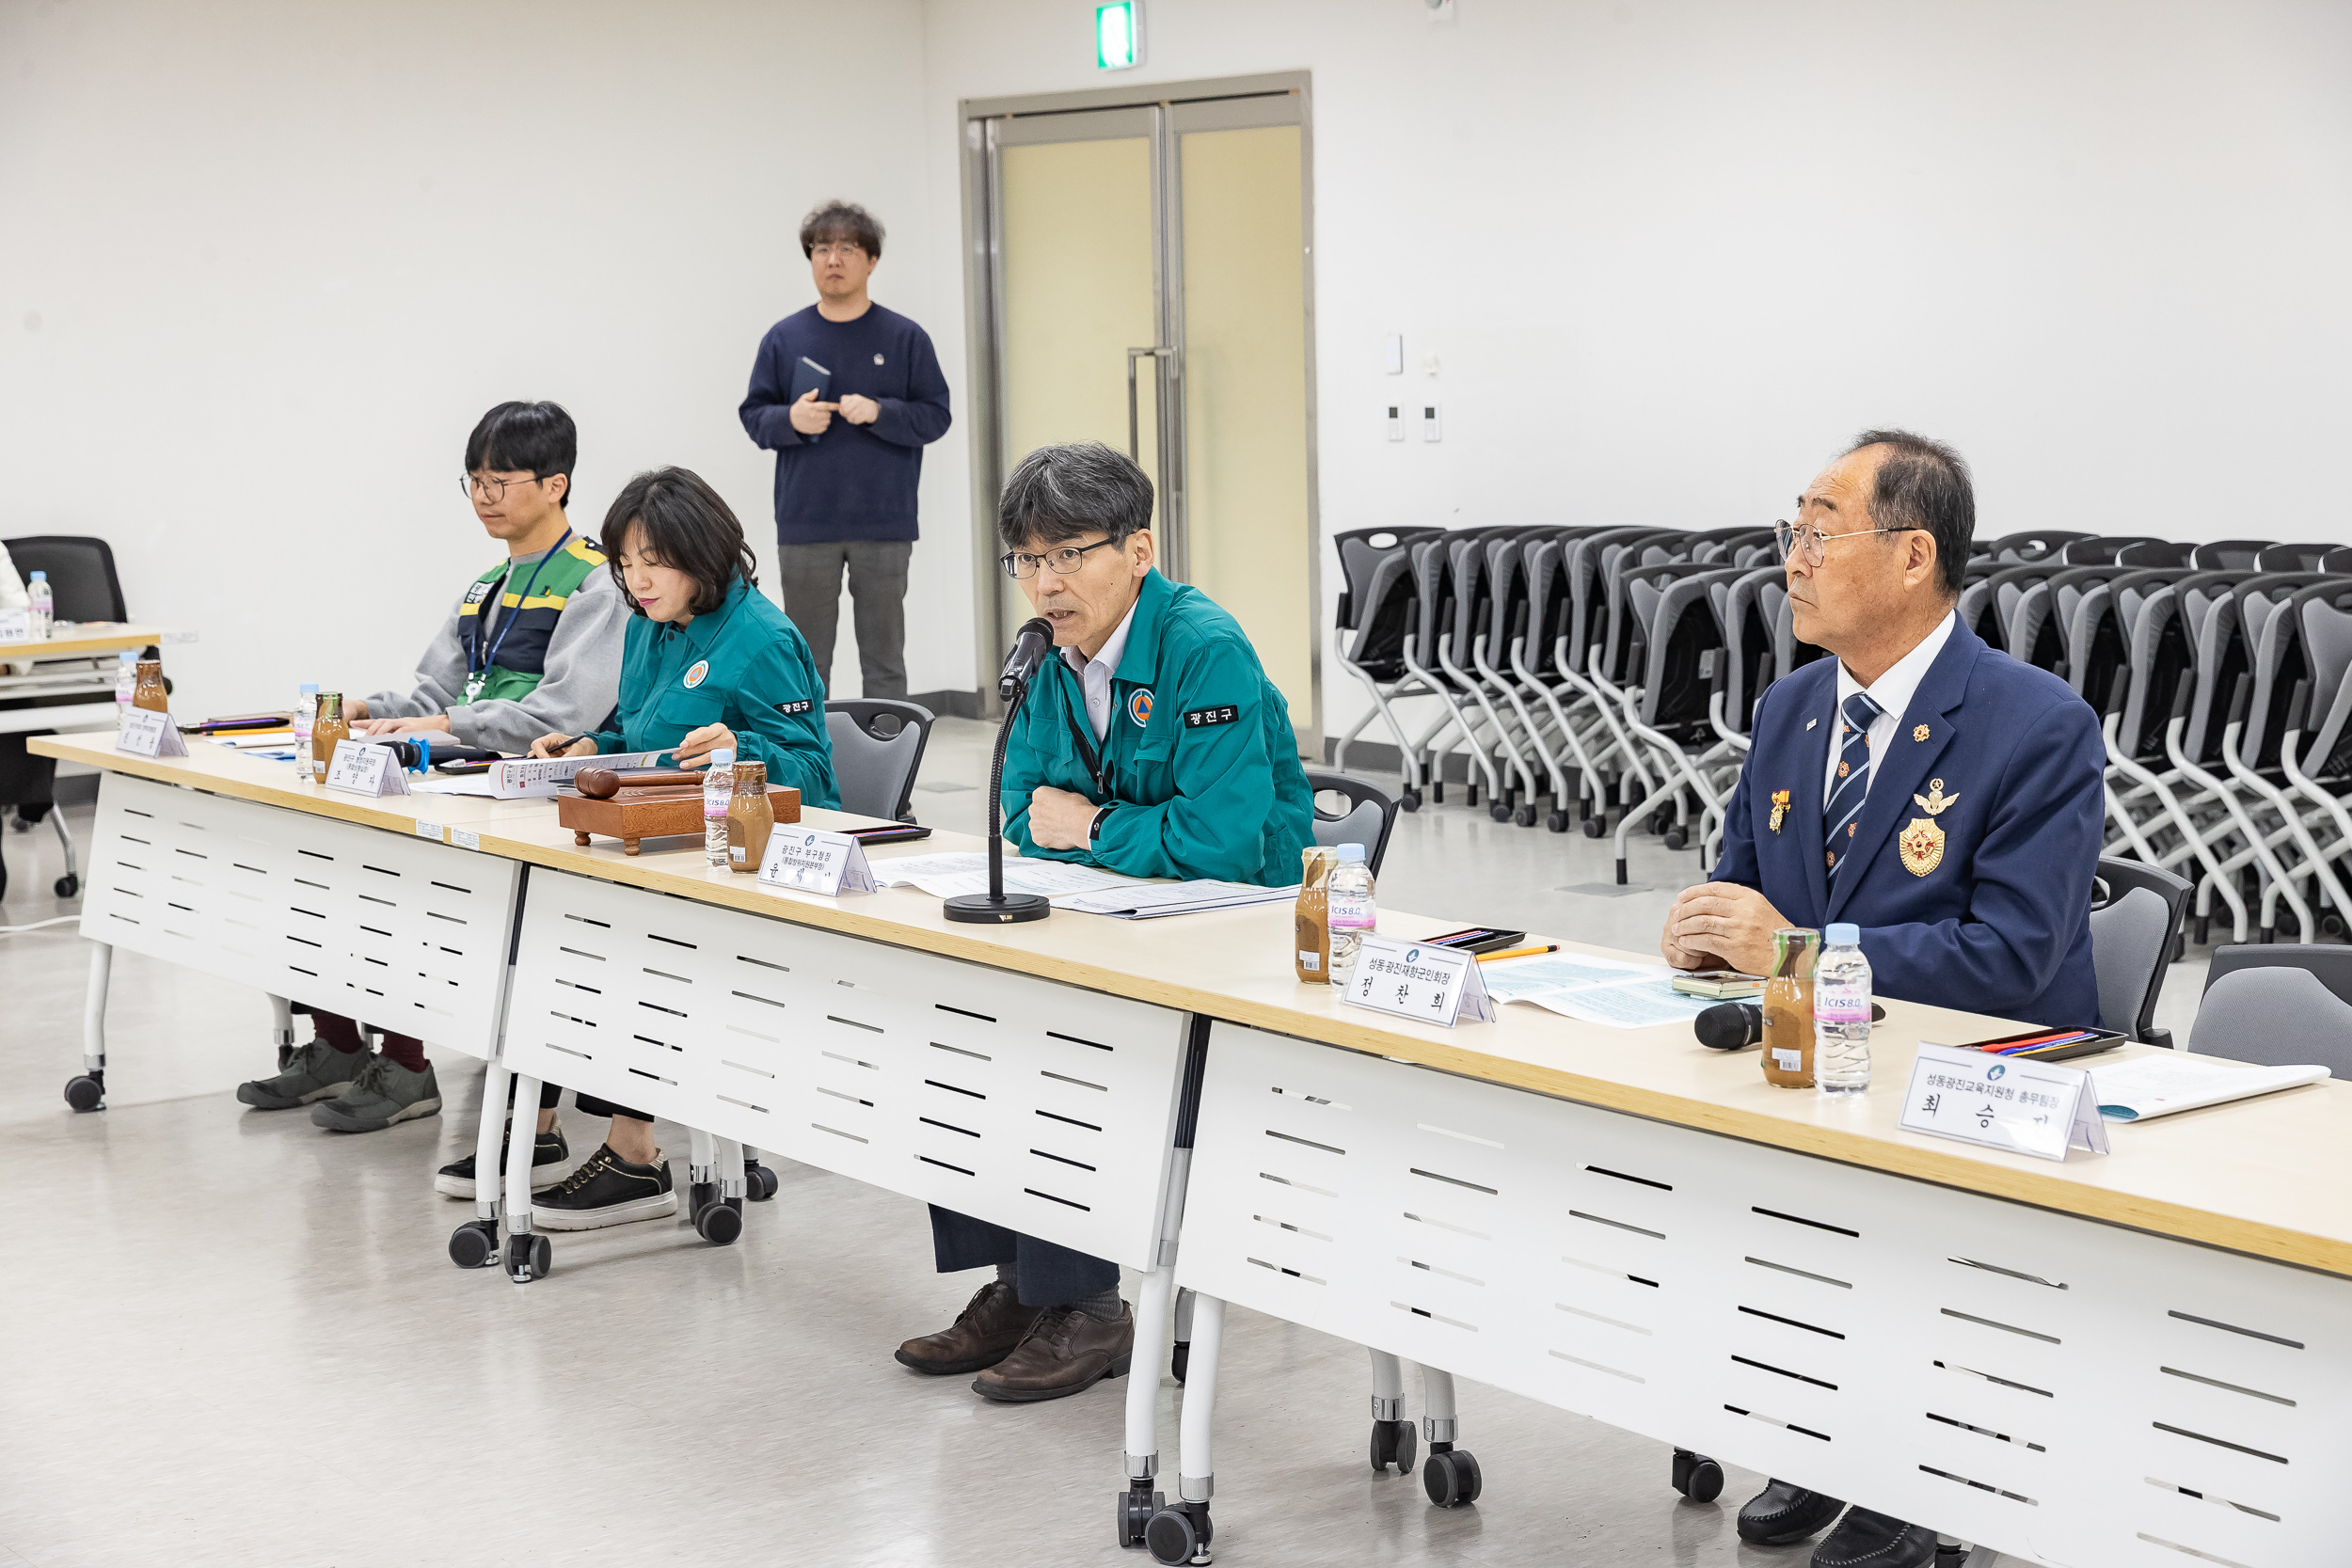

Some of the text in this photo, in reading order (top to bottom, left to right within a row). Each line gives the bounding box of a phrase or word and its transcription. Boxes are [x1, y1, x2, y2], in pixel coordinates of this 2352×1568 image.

[783, 701, 809, 713] 광진구
[1190, 708, 1232, 725] 광진구
[782, 845, 831, 862] 광진구 부구청장
[1331, 905, 1348, 915] ICIS
[1824, 997, 1861, 1007] ICIS 8.0
